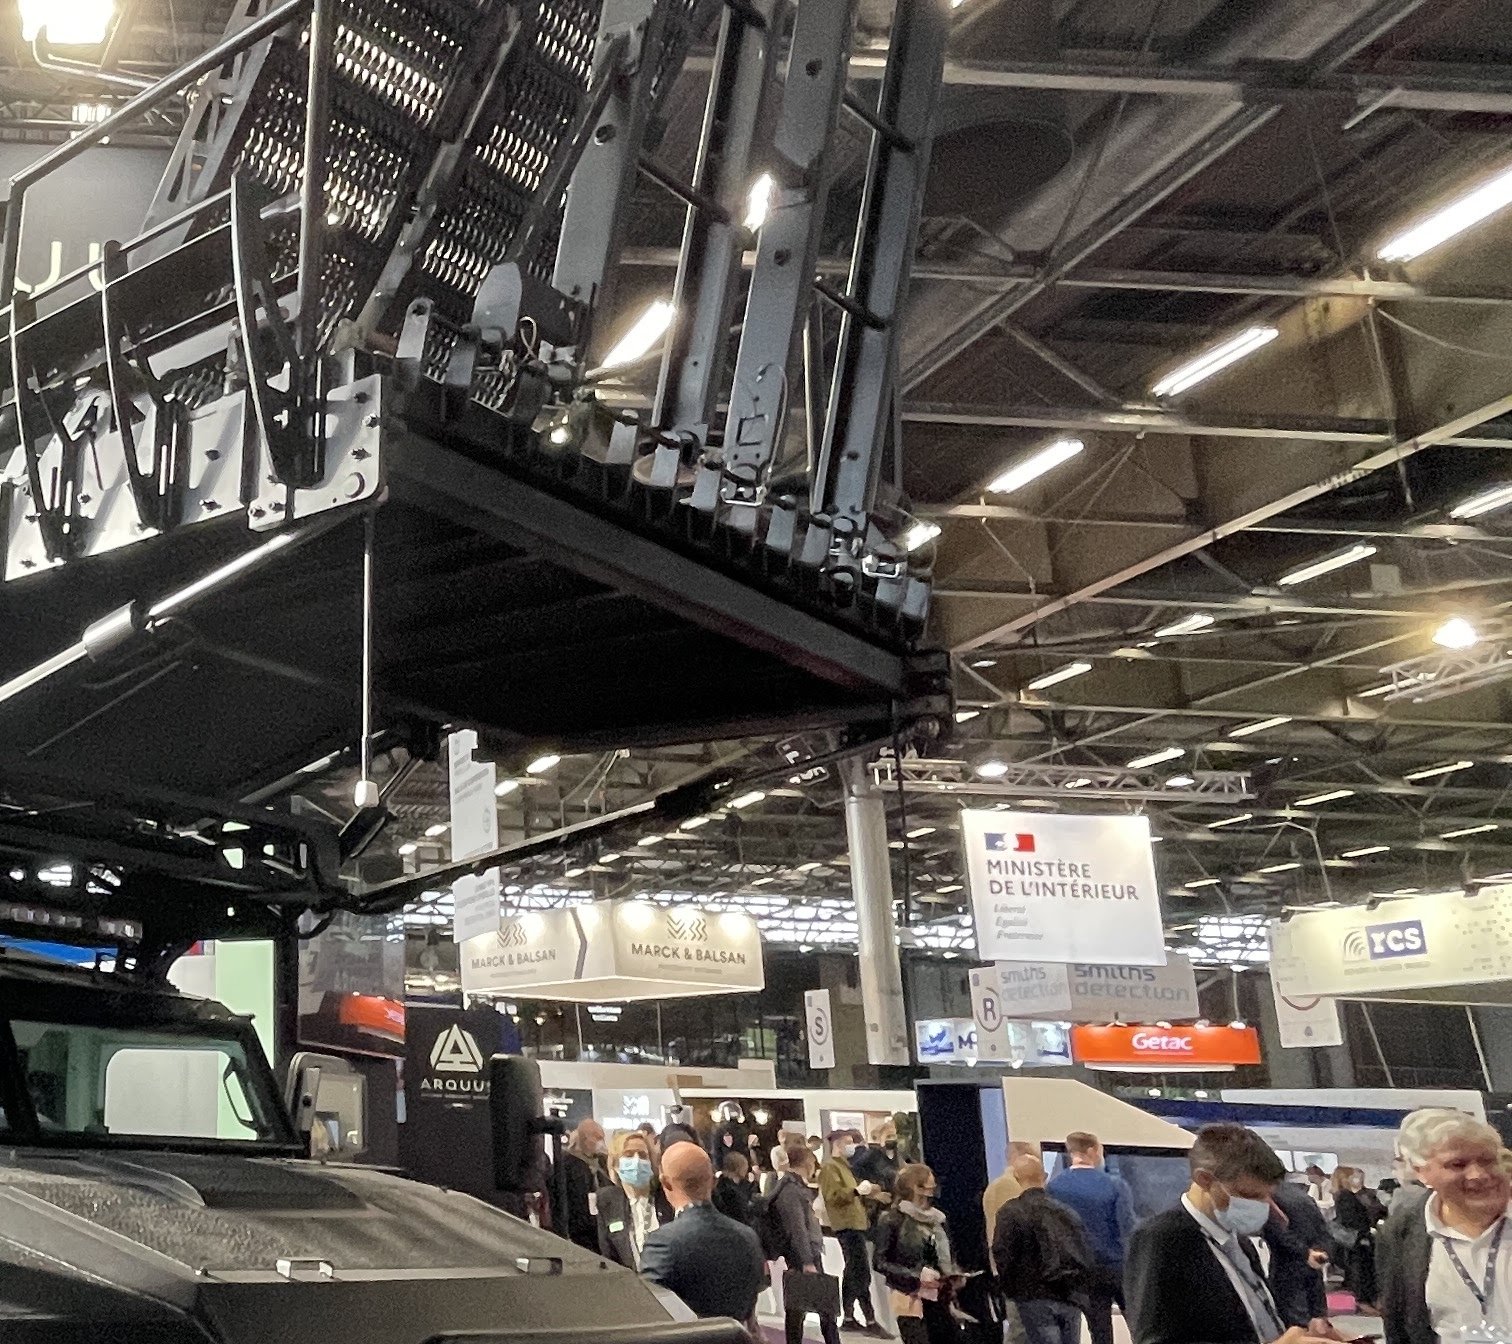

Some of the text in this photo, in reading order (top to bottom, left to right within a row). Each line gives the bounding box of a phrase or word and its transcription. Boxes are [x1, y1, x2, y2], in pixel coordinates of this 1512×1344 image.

[987, 859, 1091, 879] MINISTÈRE
[989, 879, 1139, 900] DE L'INTÉRIEUR
[1370, 927, 1422, 954] rcs
[471, 954, 505, 969] MARCK
[517, 949, 556, 965] BALSAN
[631, 943, 746, 965] MARCK & BALSAN
[983, 997, 996, 1021] R
[814, 1016, 824, 1036] S
[1132, 1032, 1193, 1052] Getac
